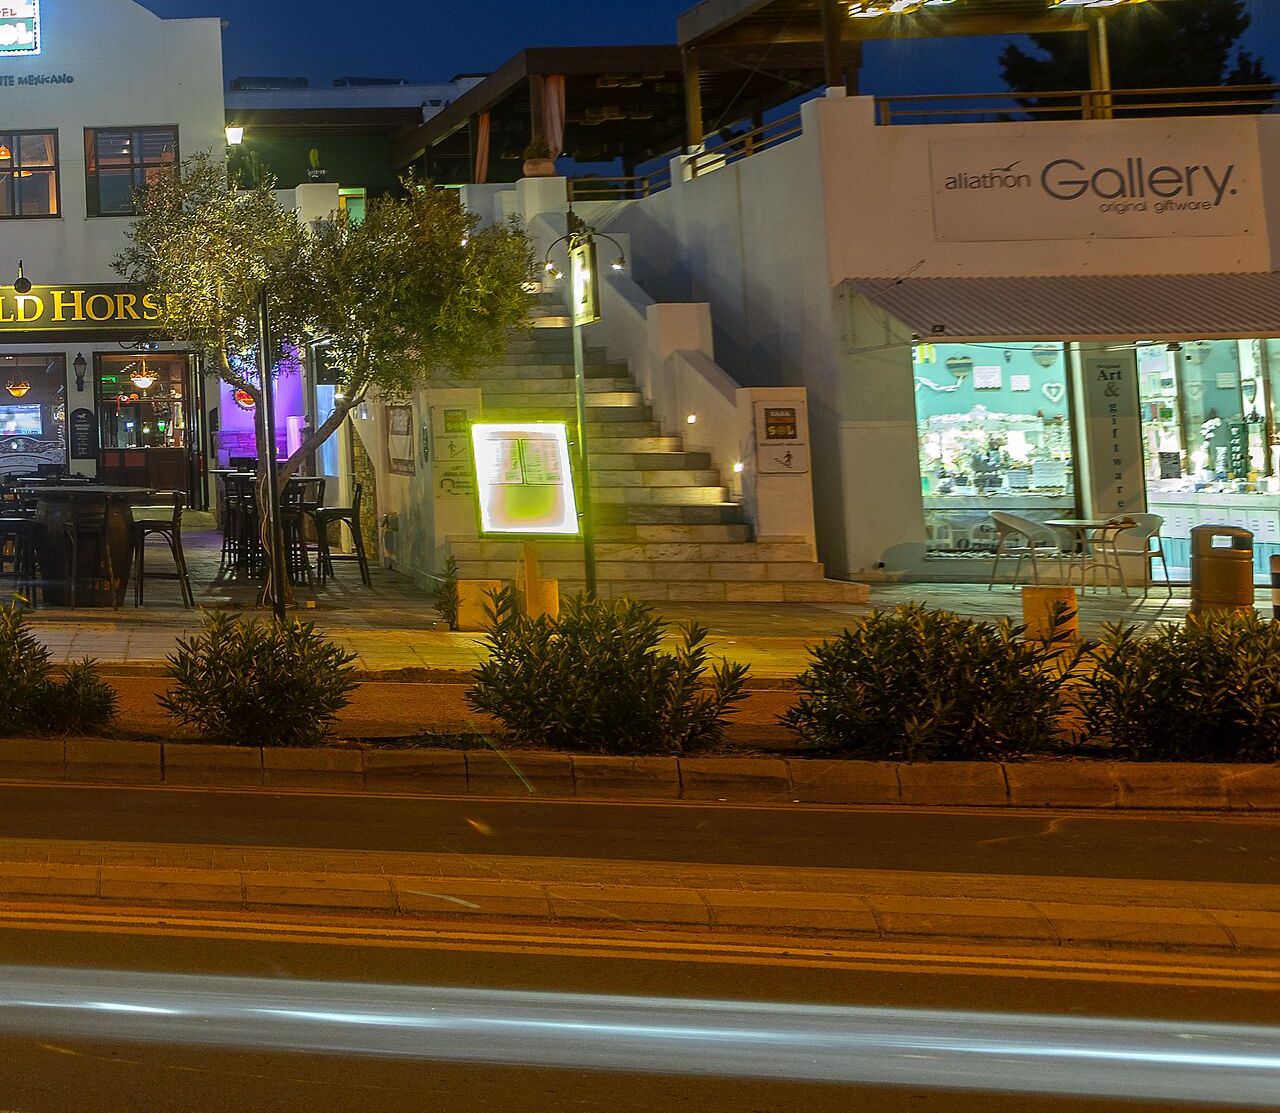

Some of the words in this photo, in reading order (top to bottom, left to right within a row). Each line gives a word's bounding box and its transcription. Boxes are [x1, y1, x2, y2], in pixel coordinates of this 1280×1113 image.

[944, 172, 1031, 190] aliathon
[1041, 157, 1238, 206] Gallery.
[1099, 199, 1146, 215] original
[1153, 197, 1212, 214] giftware
[1097, 369, 1123, 381] Art
[1104, 381, 1120, 398] &
